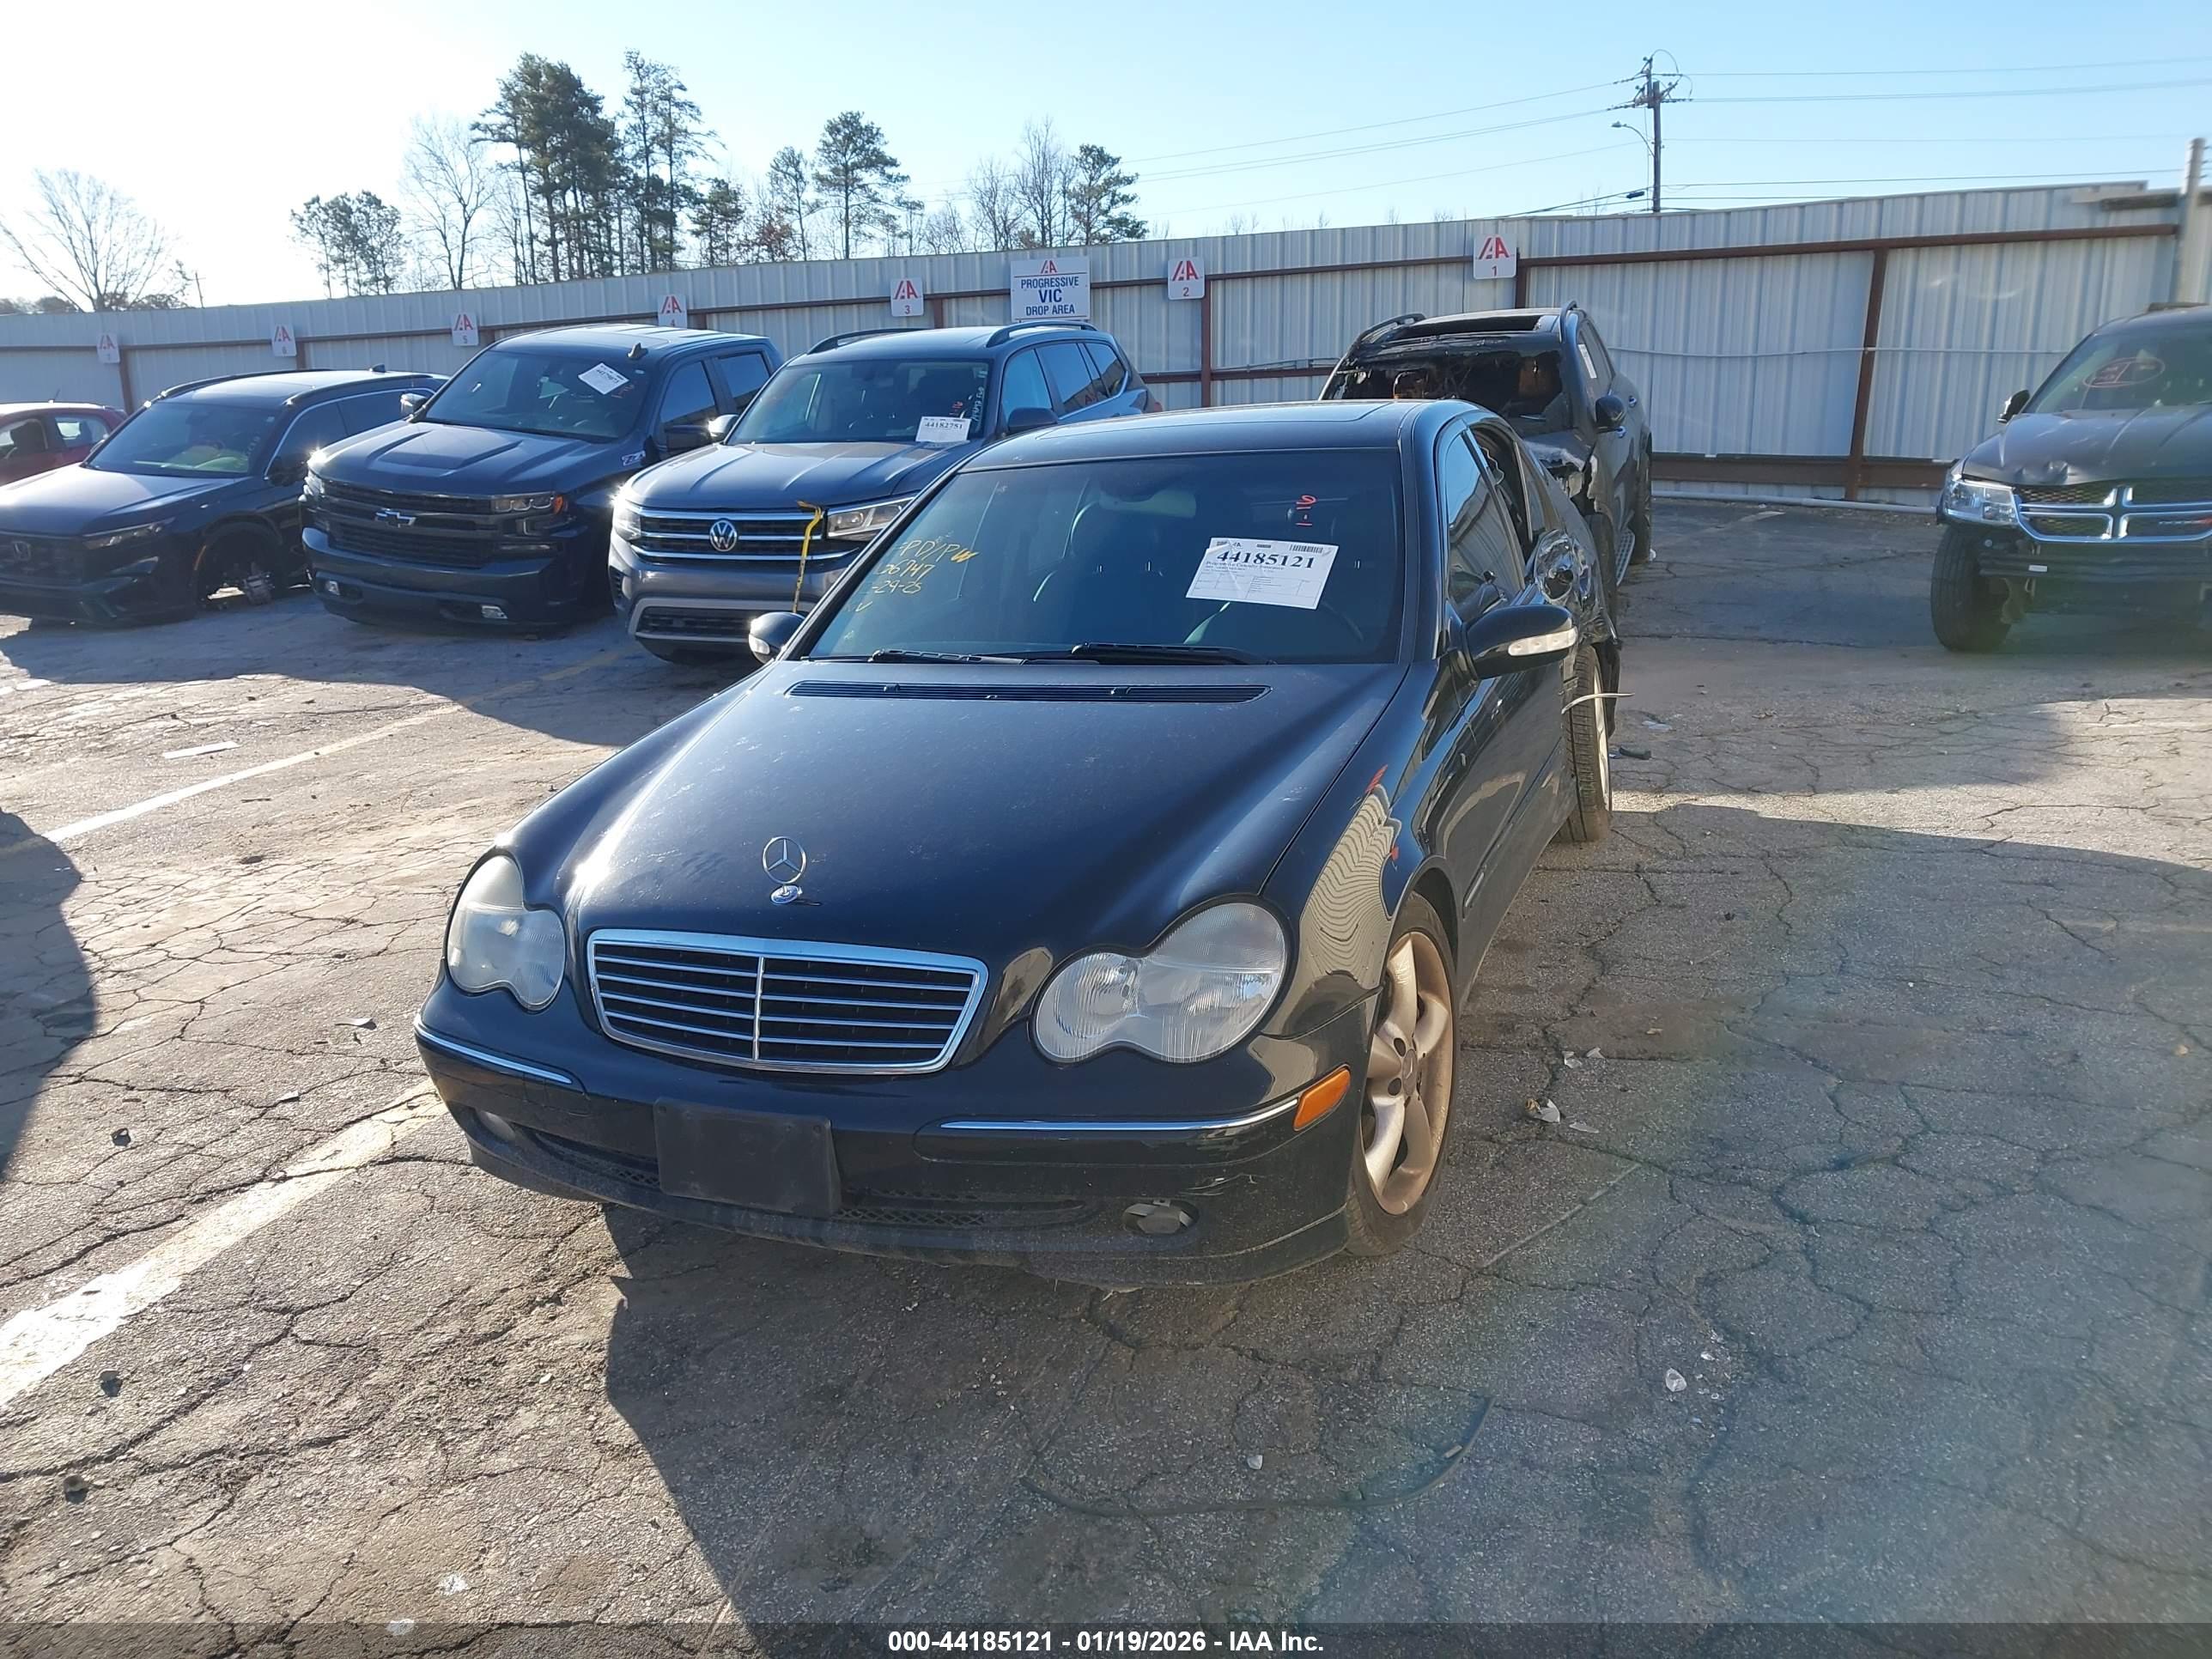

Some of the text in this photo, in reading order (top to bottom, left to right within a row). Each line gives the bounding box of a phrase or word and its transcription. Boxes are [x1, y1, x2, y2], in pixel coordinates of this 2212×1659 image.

[1491, 265, 1498, 276] 1
[1020, 276, 1079, 289] PROGRESSIVE
[1038, 289, 1063, 303] VIC
[1182, 287, 1189, 297] 2
[904, 305, 911, 315] 3
[1025, 304, 1075, 316] DROP AREA
[1217, 550, 1315, 568] 44185121
